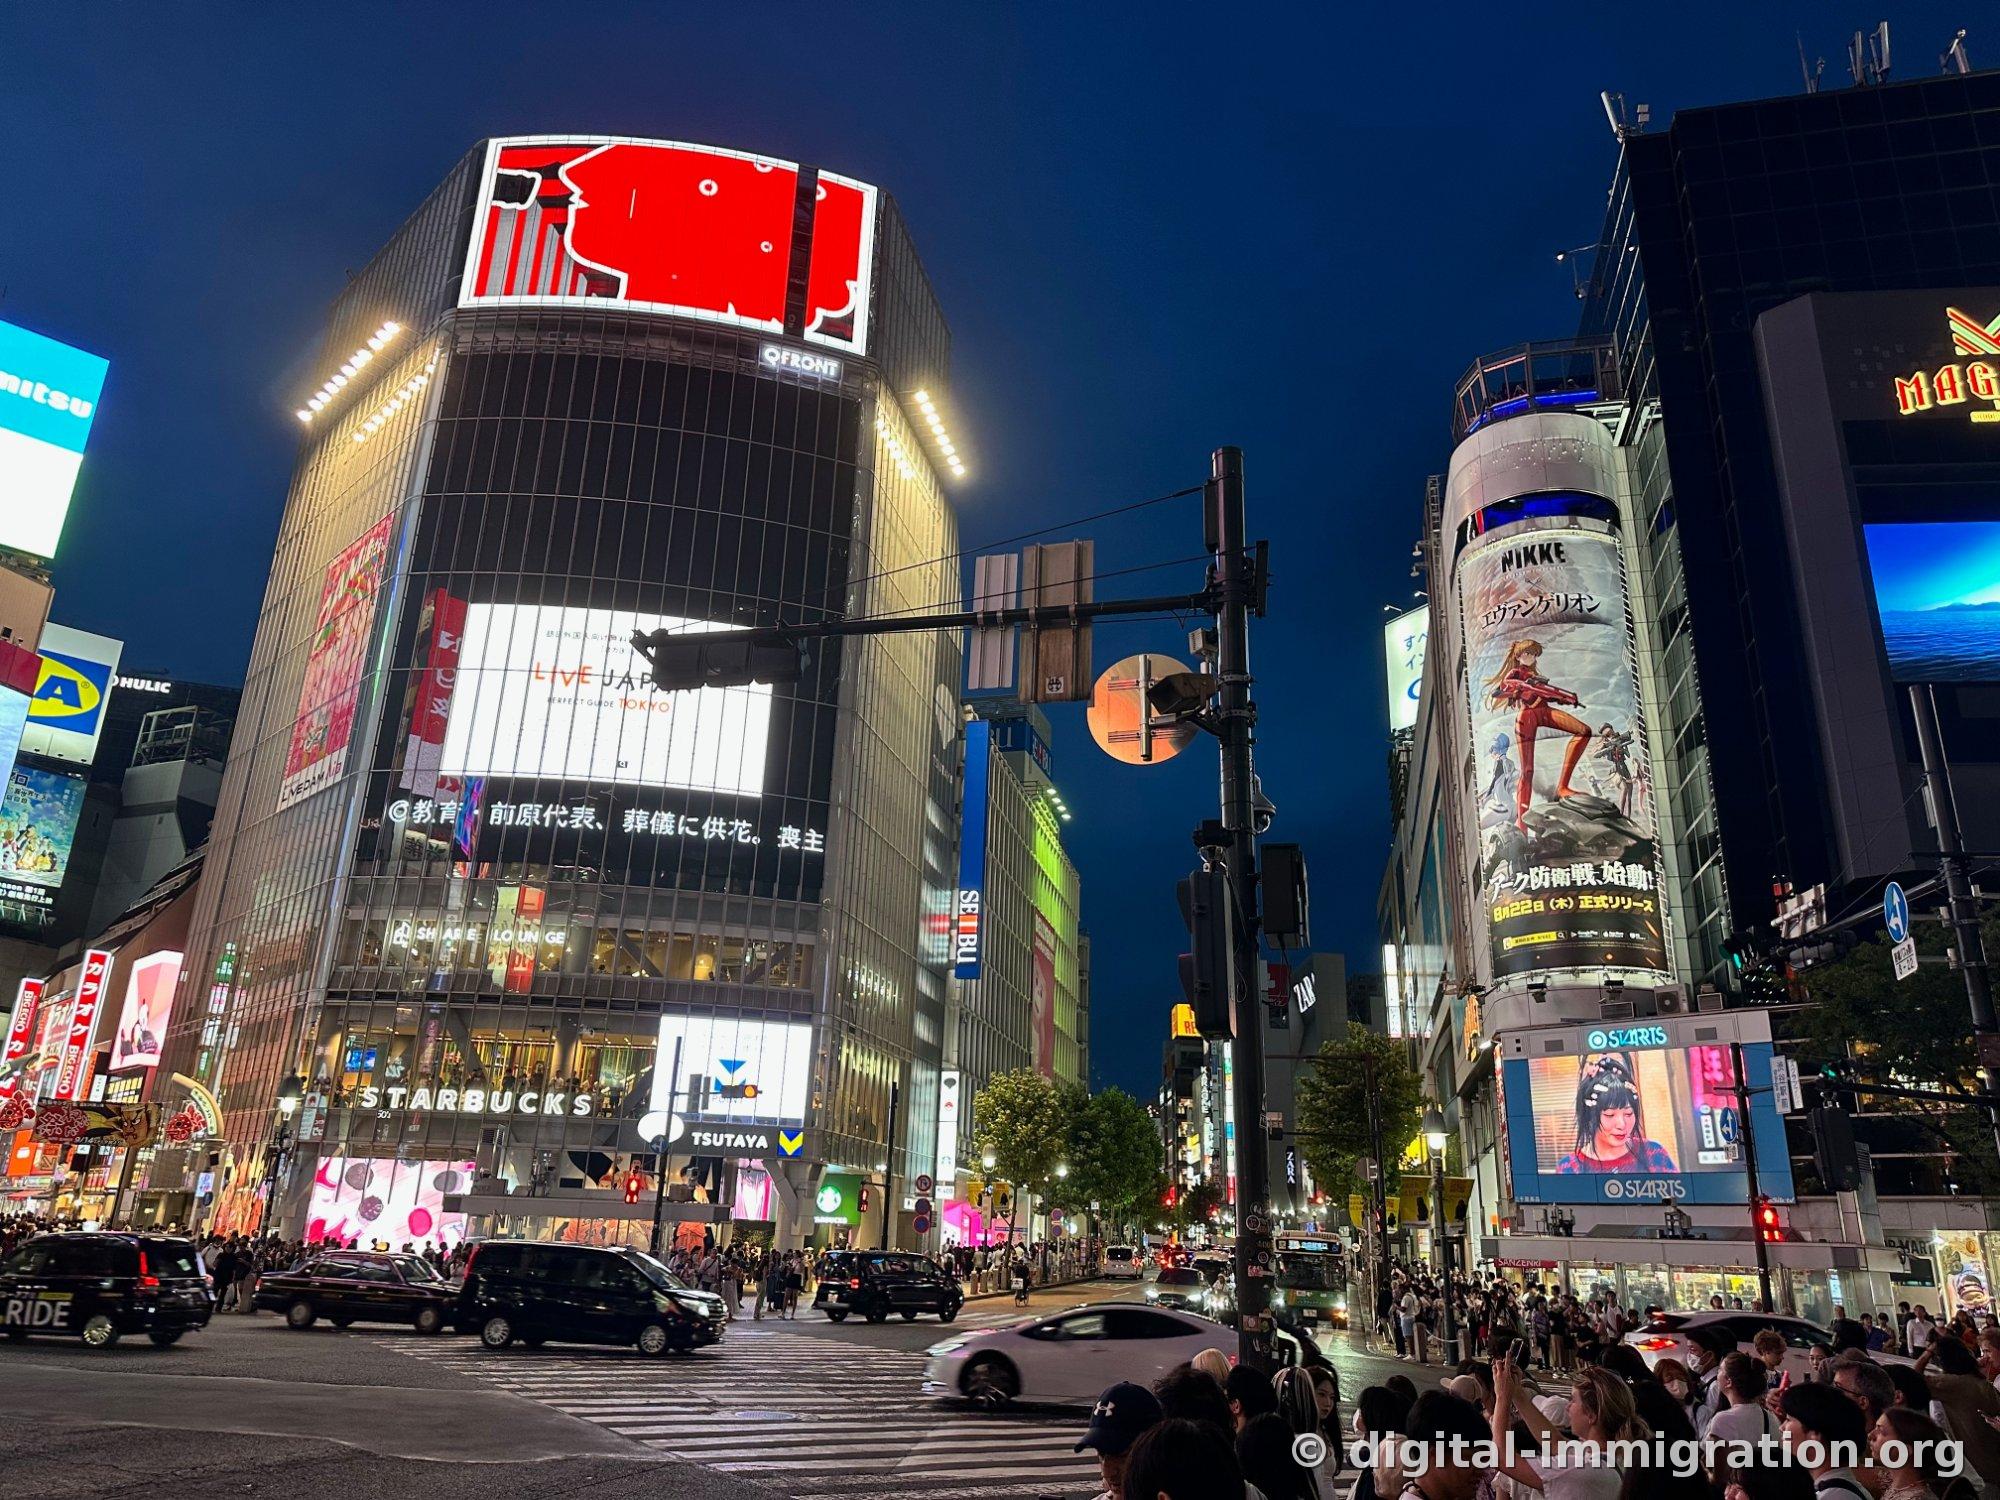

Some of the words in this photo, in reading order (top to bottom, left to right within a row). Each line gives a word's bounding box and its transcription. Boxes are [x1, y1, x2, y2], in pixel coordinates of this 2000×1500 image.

[1501, 542, 1566, 573] NIKKE
[1481, 592, 1601, 629] エヴァンゲリオン
[120, 678, 172, 694] HULIC
[535, 661, 593, 688] LIVE
[601, 669, 692, 695] JAP
[619, 697, 670, 713] TOKYO
[622, 808, 761, 845] 葬儀に供花。
[777, 824, 825, 853] 喪主
[1578, 894, 1655, 914] 正式リリース
[417, 926, 478, 942] SHARE
[493, 928, 567, 944] LOUNGE
[71, 961, 104, 1037] カラオケ
[361, 1086, 592, 1115] STARBUCKS
[691, 1131, 769, 1149] TSUTAYA
[1286, 1151, 1296, 1184] ZARA
[1625, 1178, 1686, 1199] STARTS
[5, 1299, 72, 1327] RIDE
